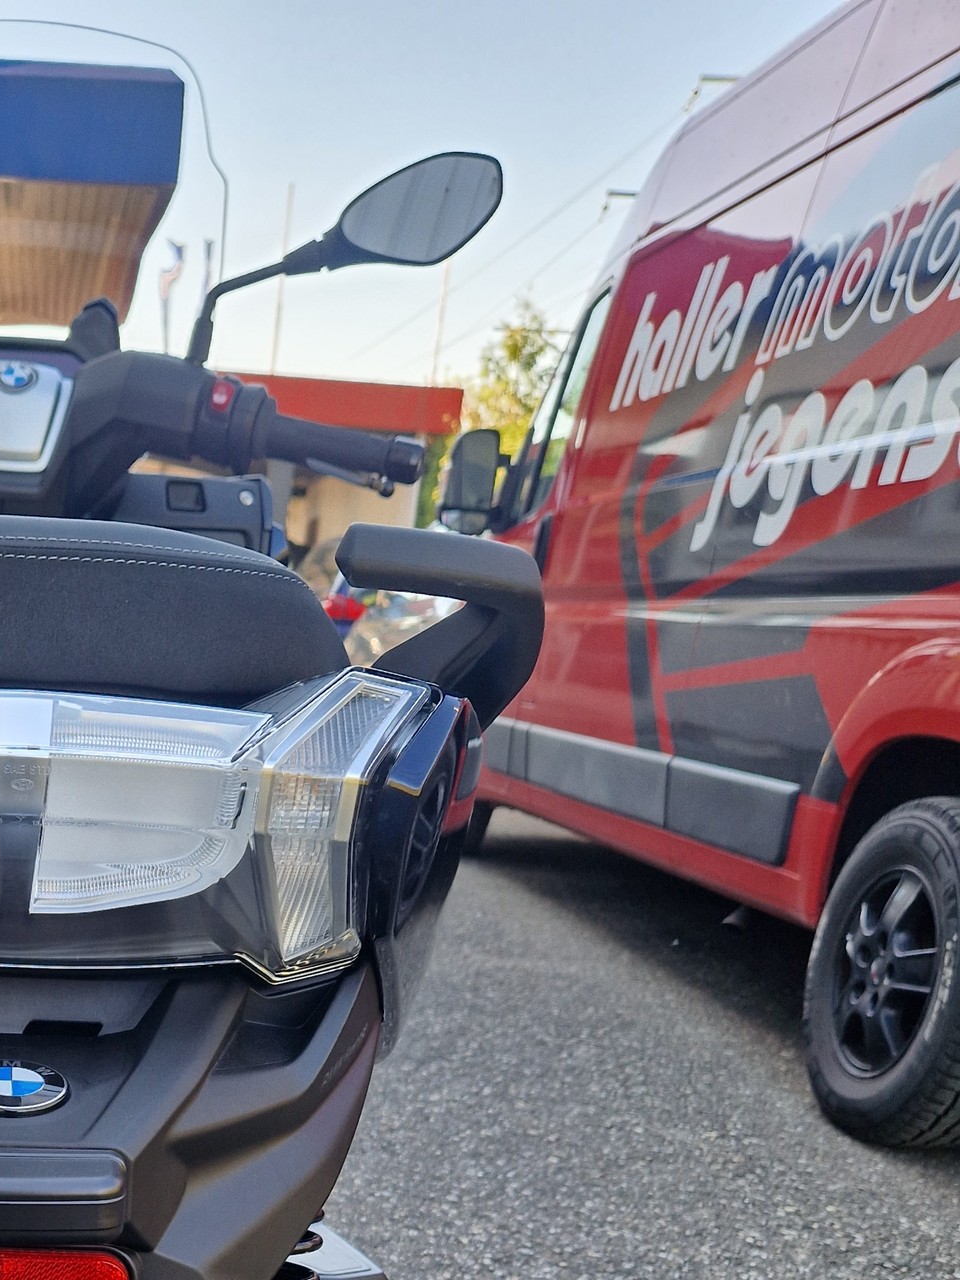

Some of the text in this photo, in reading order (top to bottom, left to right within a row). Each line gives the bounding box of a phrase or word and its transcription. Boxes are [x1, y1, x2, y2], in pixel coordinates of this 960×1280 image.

[609, 160, 960, 412] haller moto
[689, 358, 960, 553] jegens
